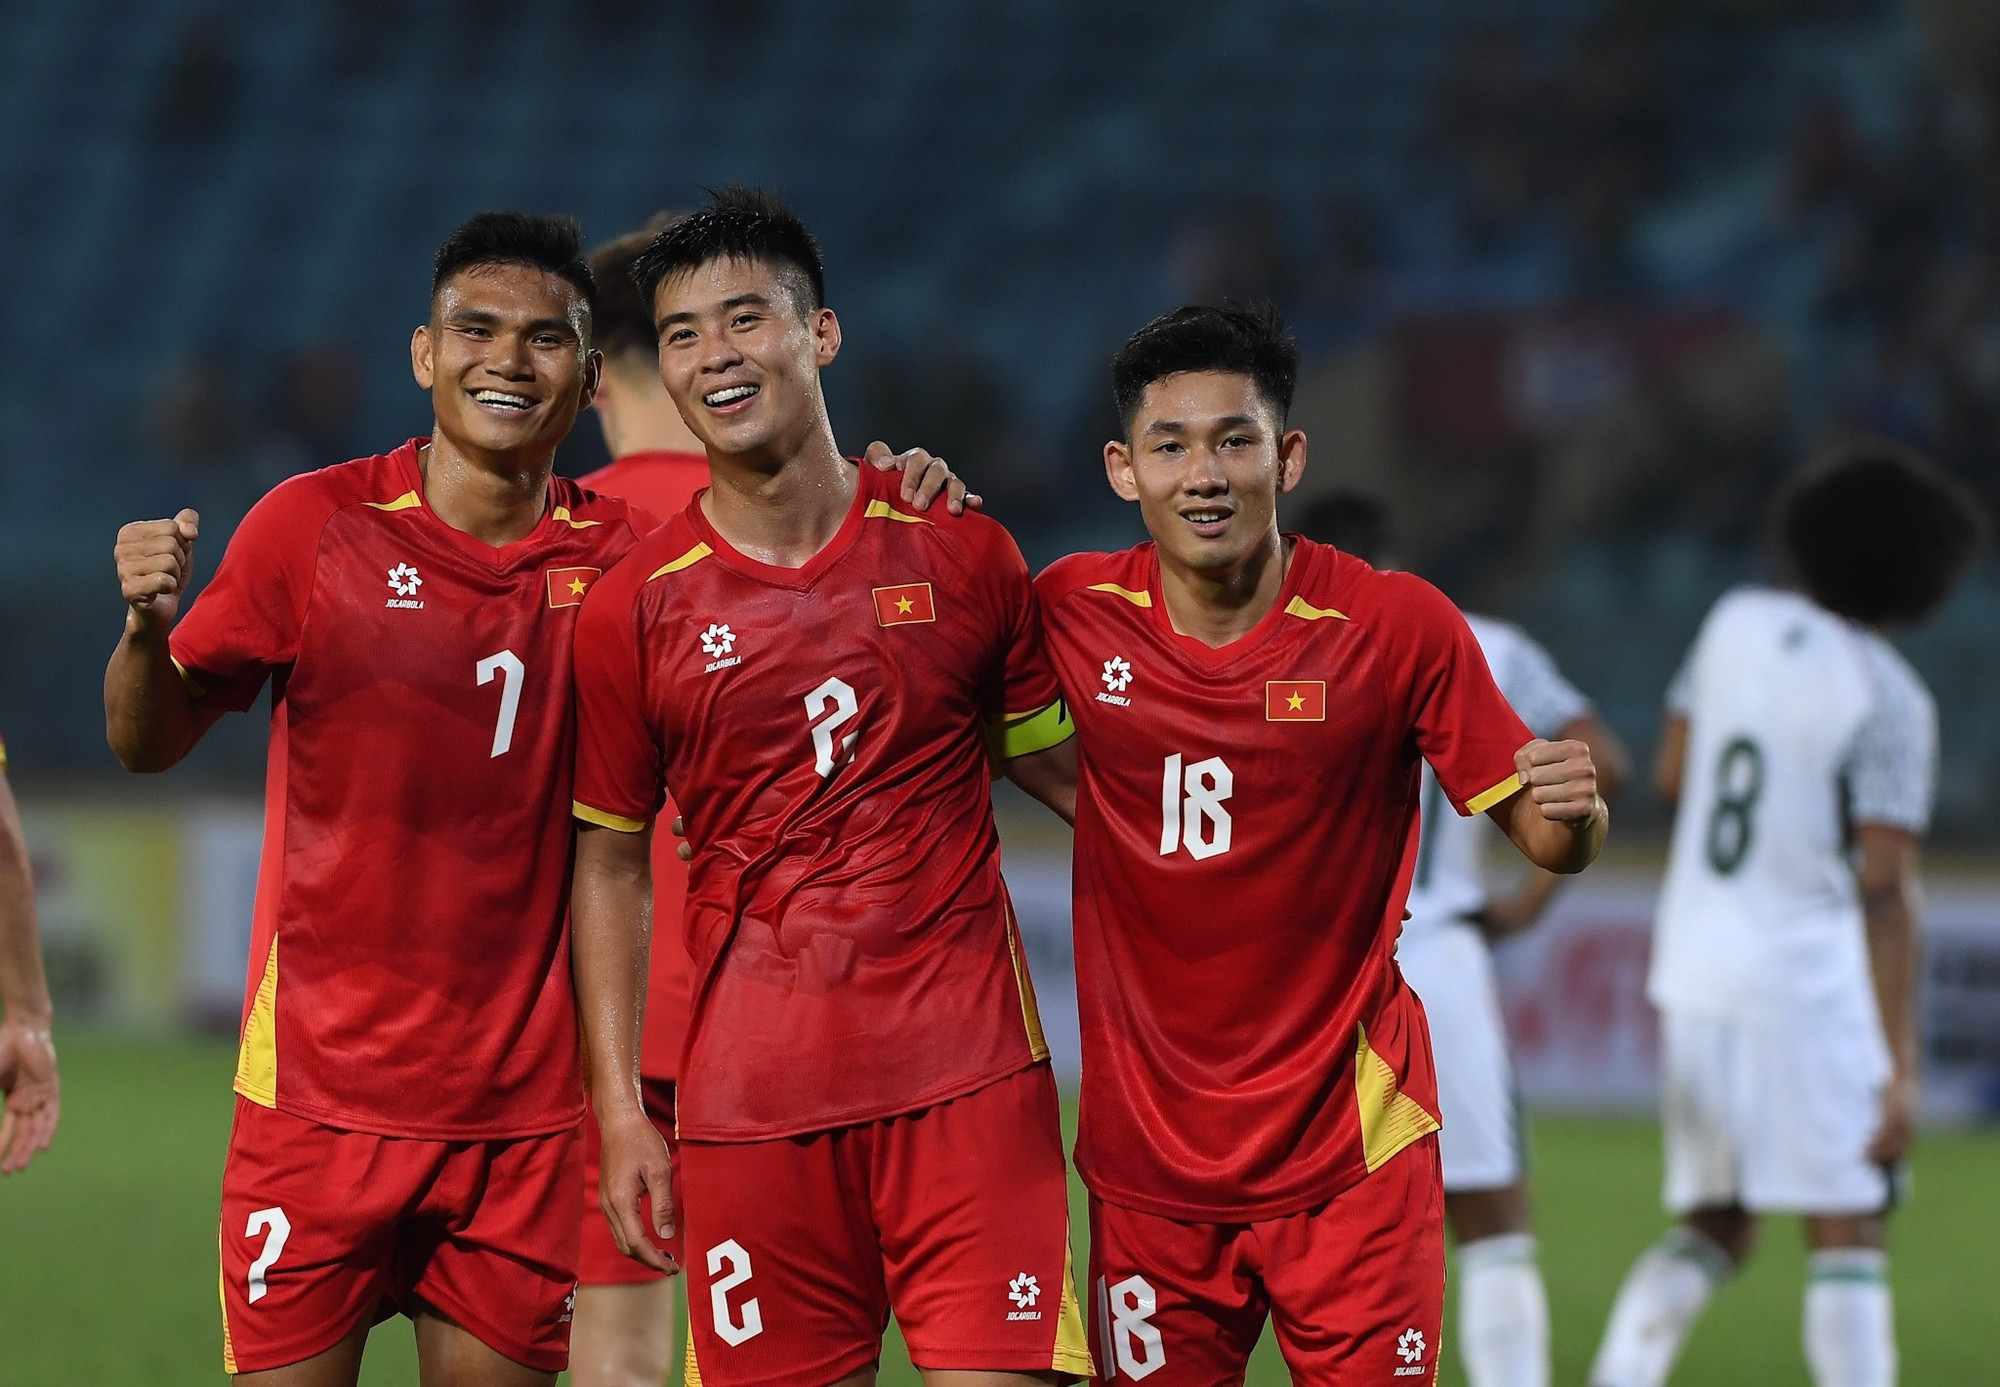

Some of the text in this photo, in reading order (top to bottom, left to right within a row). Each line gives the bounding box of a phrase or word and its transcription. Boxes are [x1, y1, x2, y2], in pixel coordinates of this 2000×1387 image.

[476, 649, 525, 759] 7
[804, 676, 859, 778] 2
[1160, 752, 1234, 861] 18
[1706, 736, 1764, 877] 8
[245, 1206, 292, 1304] 7
[706, 1238, 763, 1347] 2
[1097, 1274, 1166, 1382] 18
